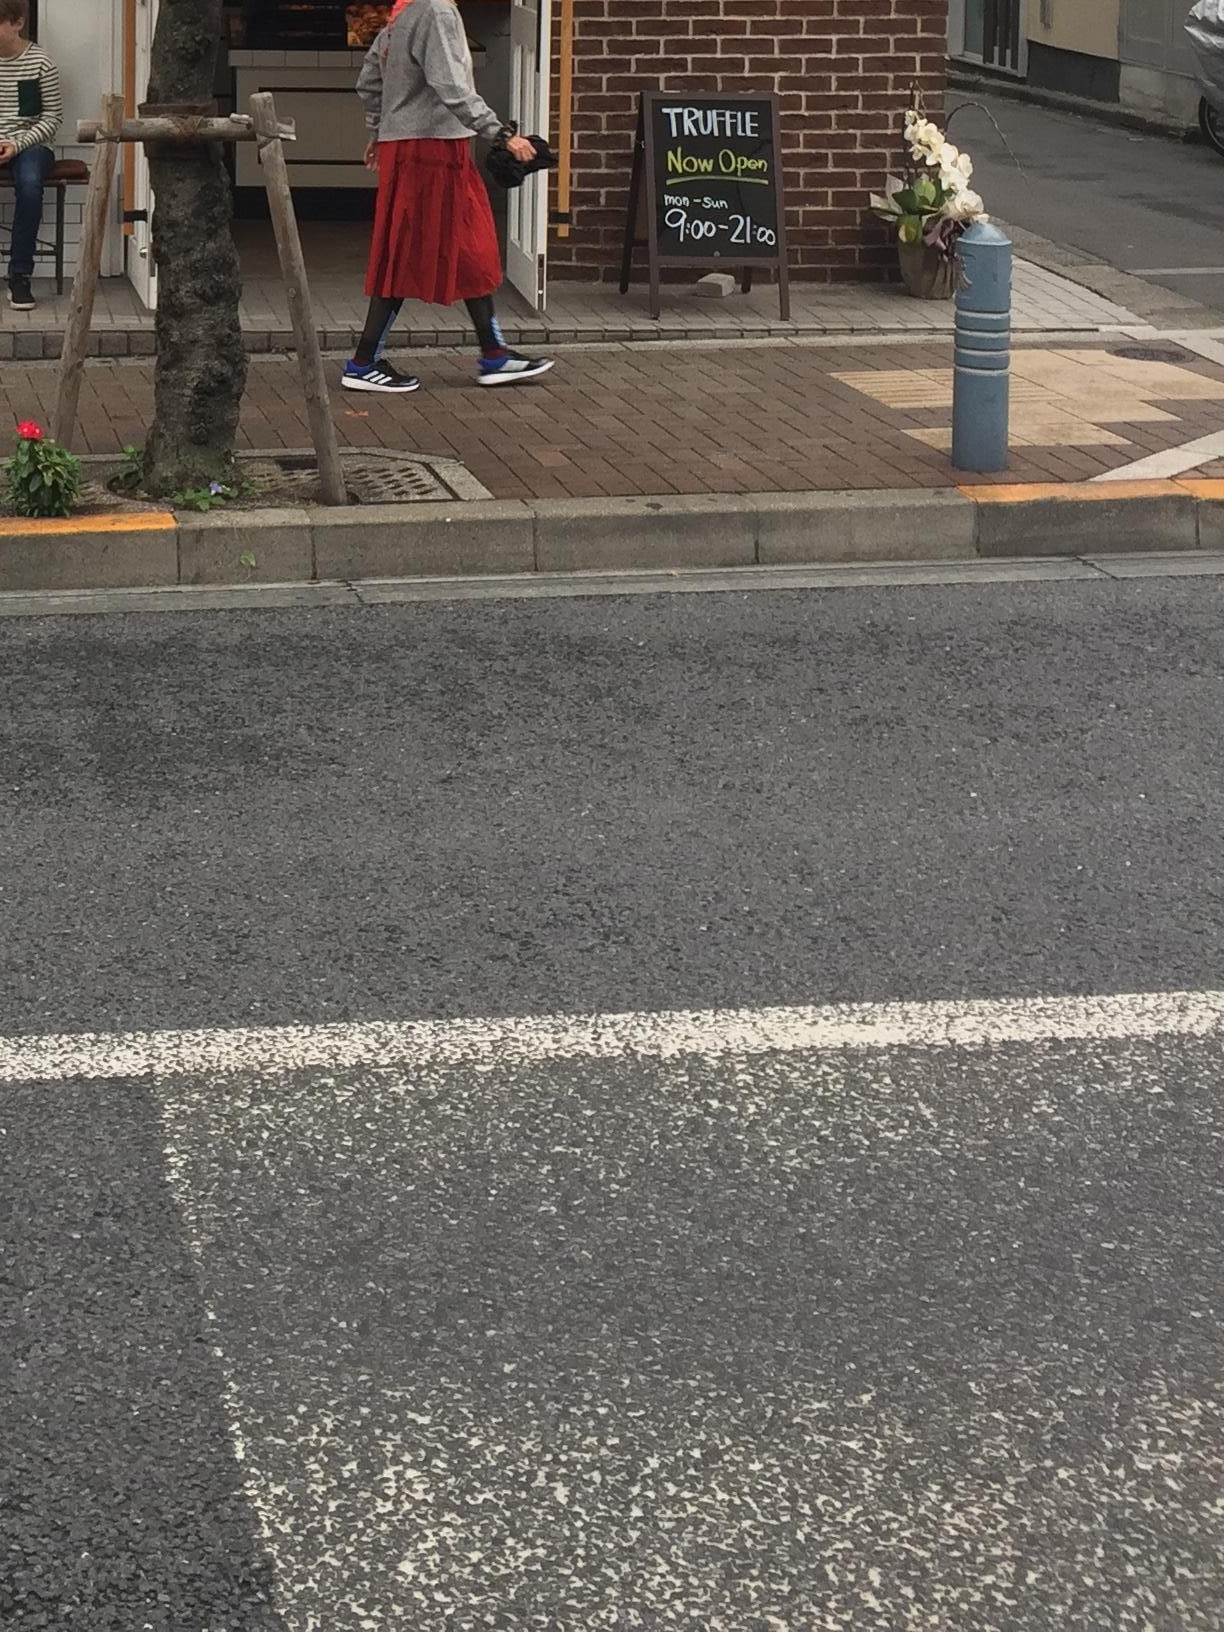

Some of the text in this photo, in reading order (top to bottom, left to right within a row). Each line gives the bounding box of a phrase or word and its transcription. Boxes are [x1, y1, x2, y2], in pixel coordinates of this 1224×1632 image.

[662, 107, 759, 138] TRUFFLE
[667, 146, 768, 177] Now Open
